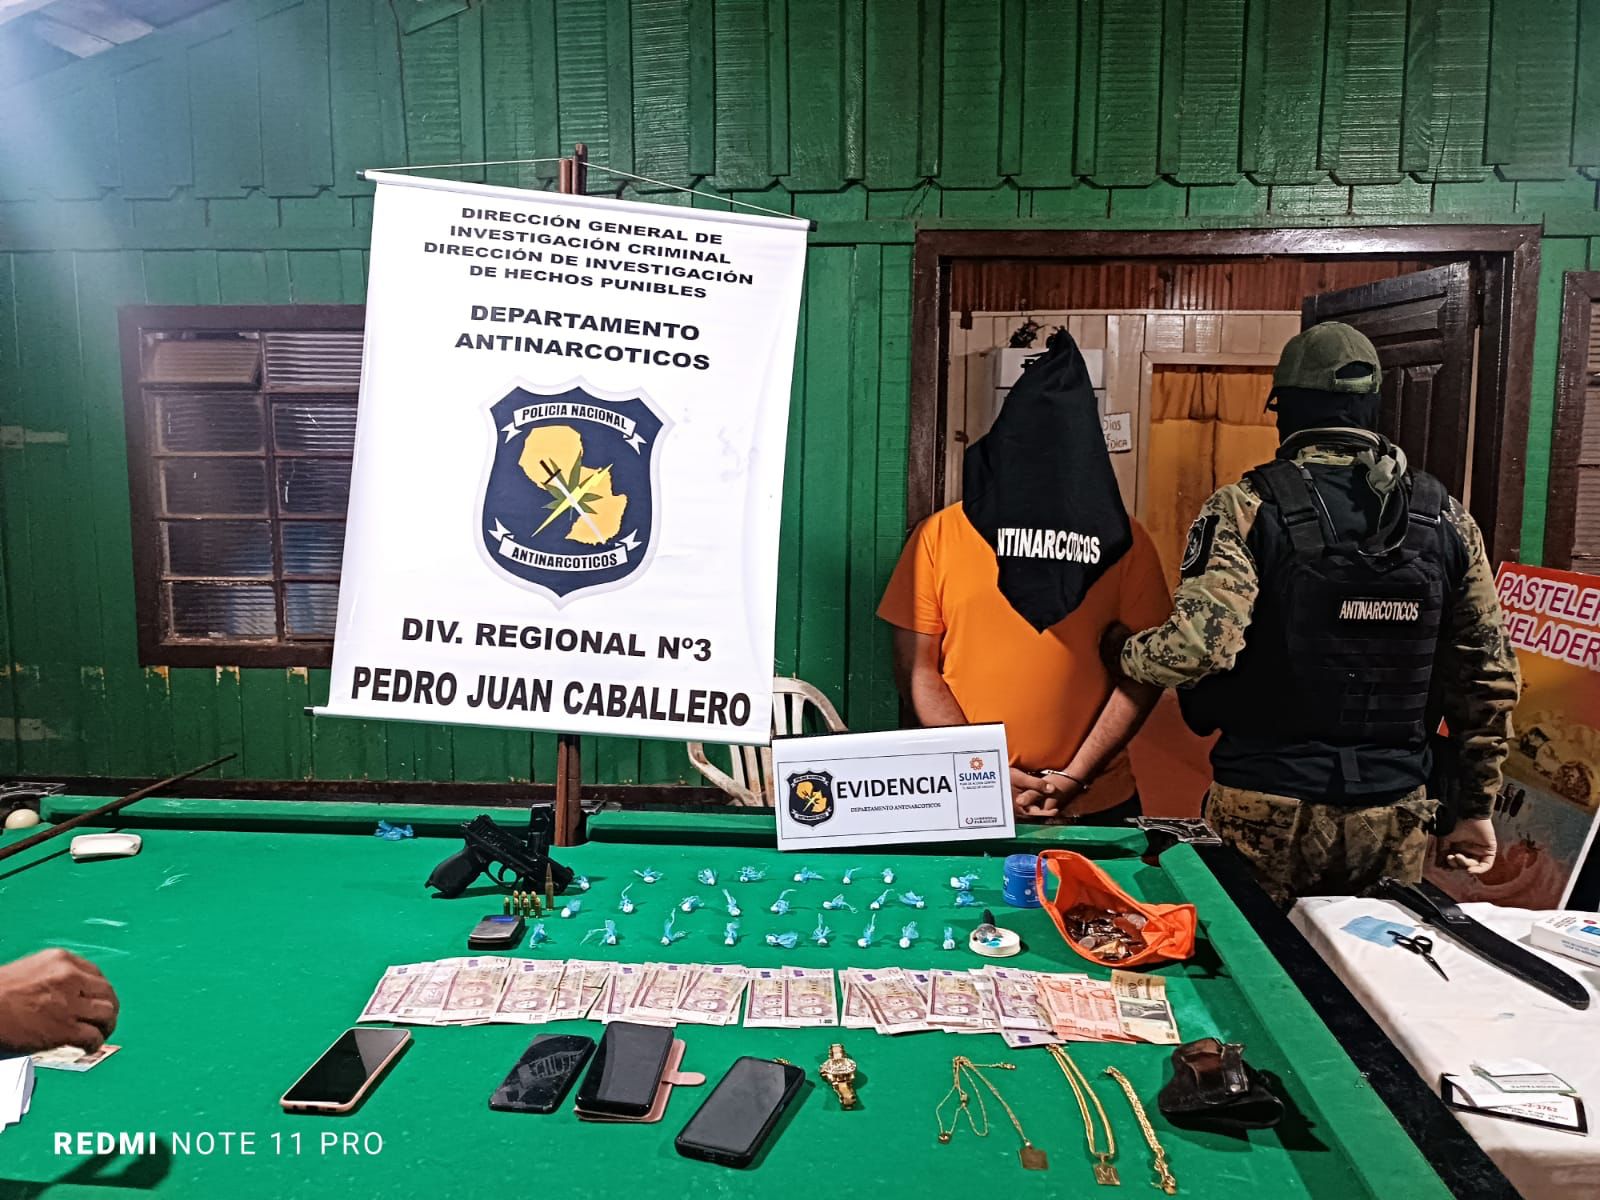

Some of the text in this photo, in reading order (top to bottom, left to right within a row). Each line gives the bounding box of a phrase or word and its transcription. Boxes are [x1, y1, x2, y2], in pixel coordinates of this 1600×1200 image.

[461, 207, 723, 245] DIRECCIÓN GENERAL DE
[450, 225, 731, 265] INVESTIGACIÓN CRIMINAL
[424, 241, 753, 285] DIRECCIÓN DE INVESTIGACIÓN
[469, 265, 707, 298] DE HECHOS PUNIBLES
[470, 305, 700, 341] DEPARTAMENTO
[454, 332, 710, 370] ANTINARCOTICOS
[521, 404, 628, 430] POLICIA NACIONAL
[511, 546, 618, 569] ANTINARCOTICOS
[1339, 600, 1420, 621] ANTINARCOTICOS
[401, 617, 463, 645] DIV.
[475, 622, 646, 657] REGIONAL
[351, 666, 751, 727] PEDRO JUAN CABALLERO
[837, 775, 953, 799] EVIDENCIA
[958, 771, 997, 782] SUMAR
[850, 802, 942, 813] DEPARTAMENTO ANTINARCOTICOS
